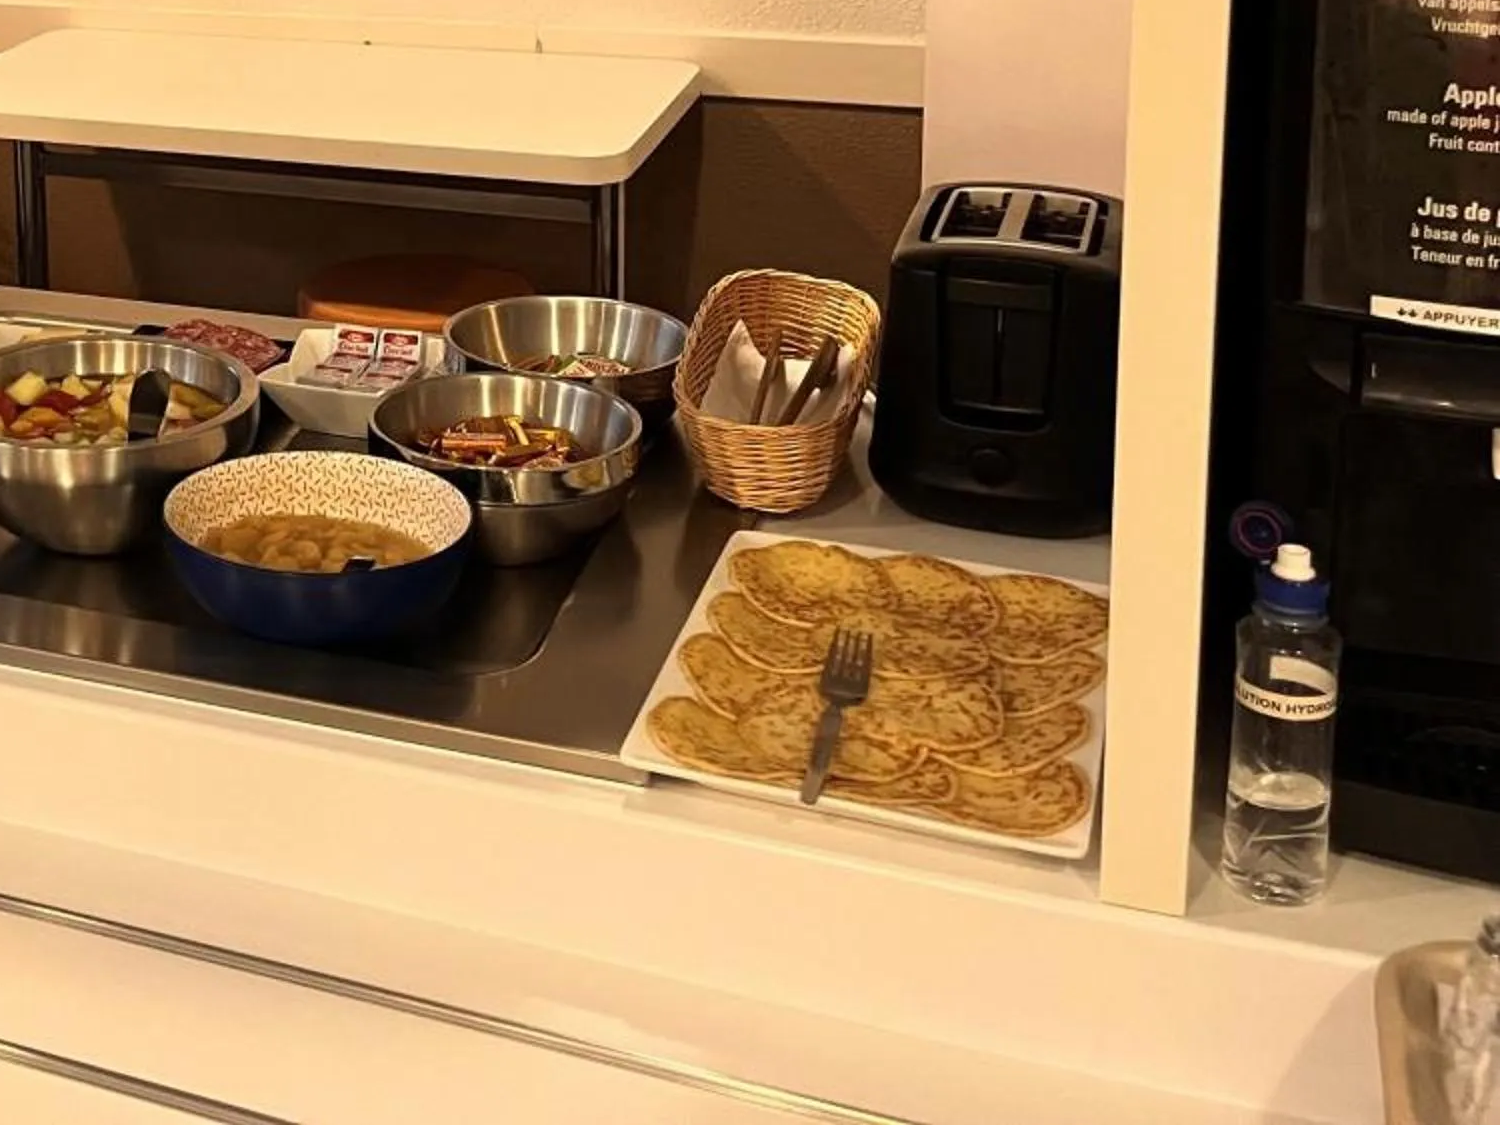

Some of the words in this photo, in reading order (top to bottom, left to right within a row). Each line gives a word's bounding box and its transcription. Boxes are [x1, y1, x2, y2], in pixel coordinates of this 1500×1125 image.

[1387, 108, 1427, 124] made
[1431, 111, 1448, 126] of
[1450, 114, 1491, 132] apple
[1429, 132, 1464, 150] Fruit
[1417, 196, 1459, 219] Jus
[1463, 201, 1491, 222] de
[1423, 224, 1459, 242] base
[1461, 228, 1481, 244] de
[1411, 245, 1463, 265] Teneur
[1465, 255, 1485, 268] en
[1423, 309, 1500, 329] APPUYER
